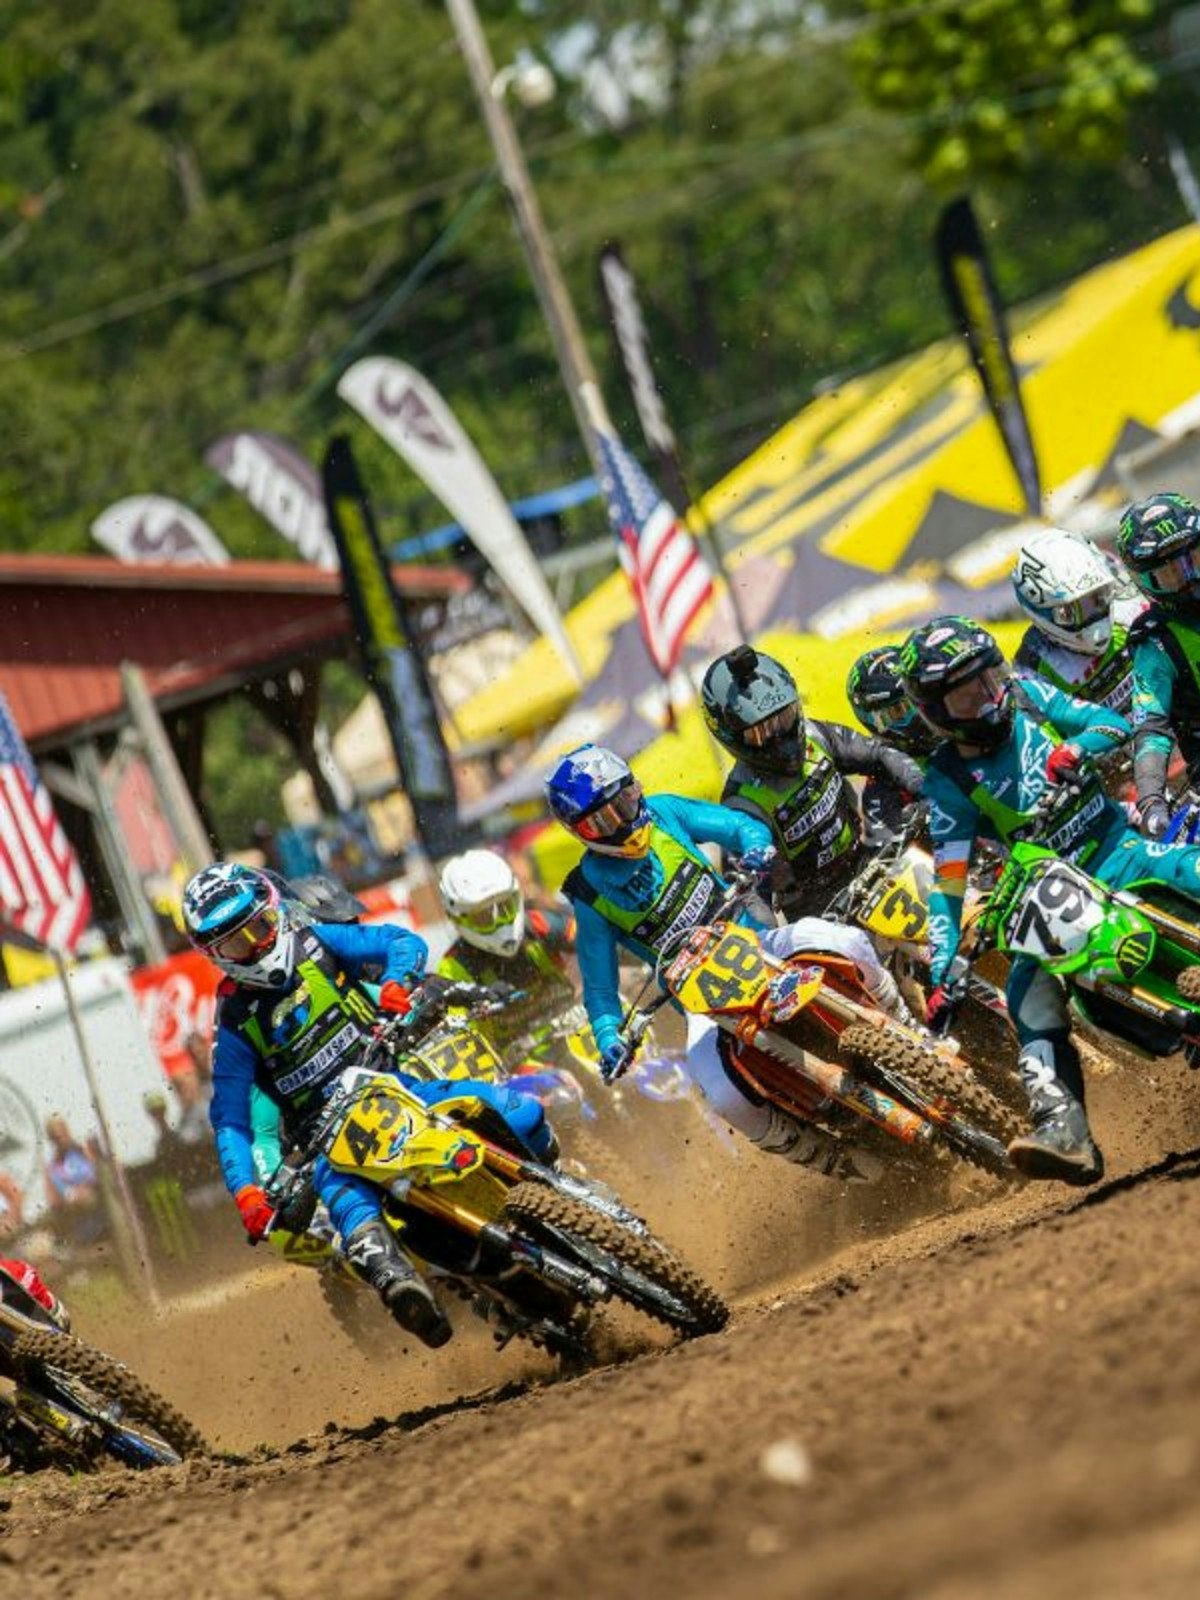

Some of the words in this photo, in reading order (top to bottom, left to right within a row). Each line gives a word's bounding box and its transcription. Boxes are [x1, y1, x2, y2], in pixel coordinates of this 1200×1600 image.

[883, 887, 928, 938] 3
[1014, 868, 1092, 956] 79
[696, 934, 765, 1009] 48
[344, 1089, 402, 1167] 43
